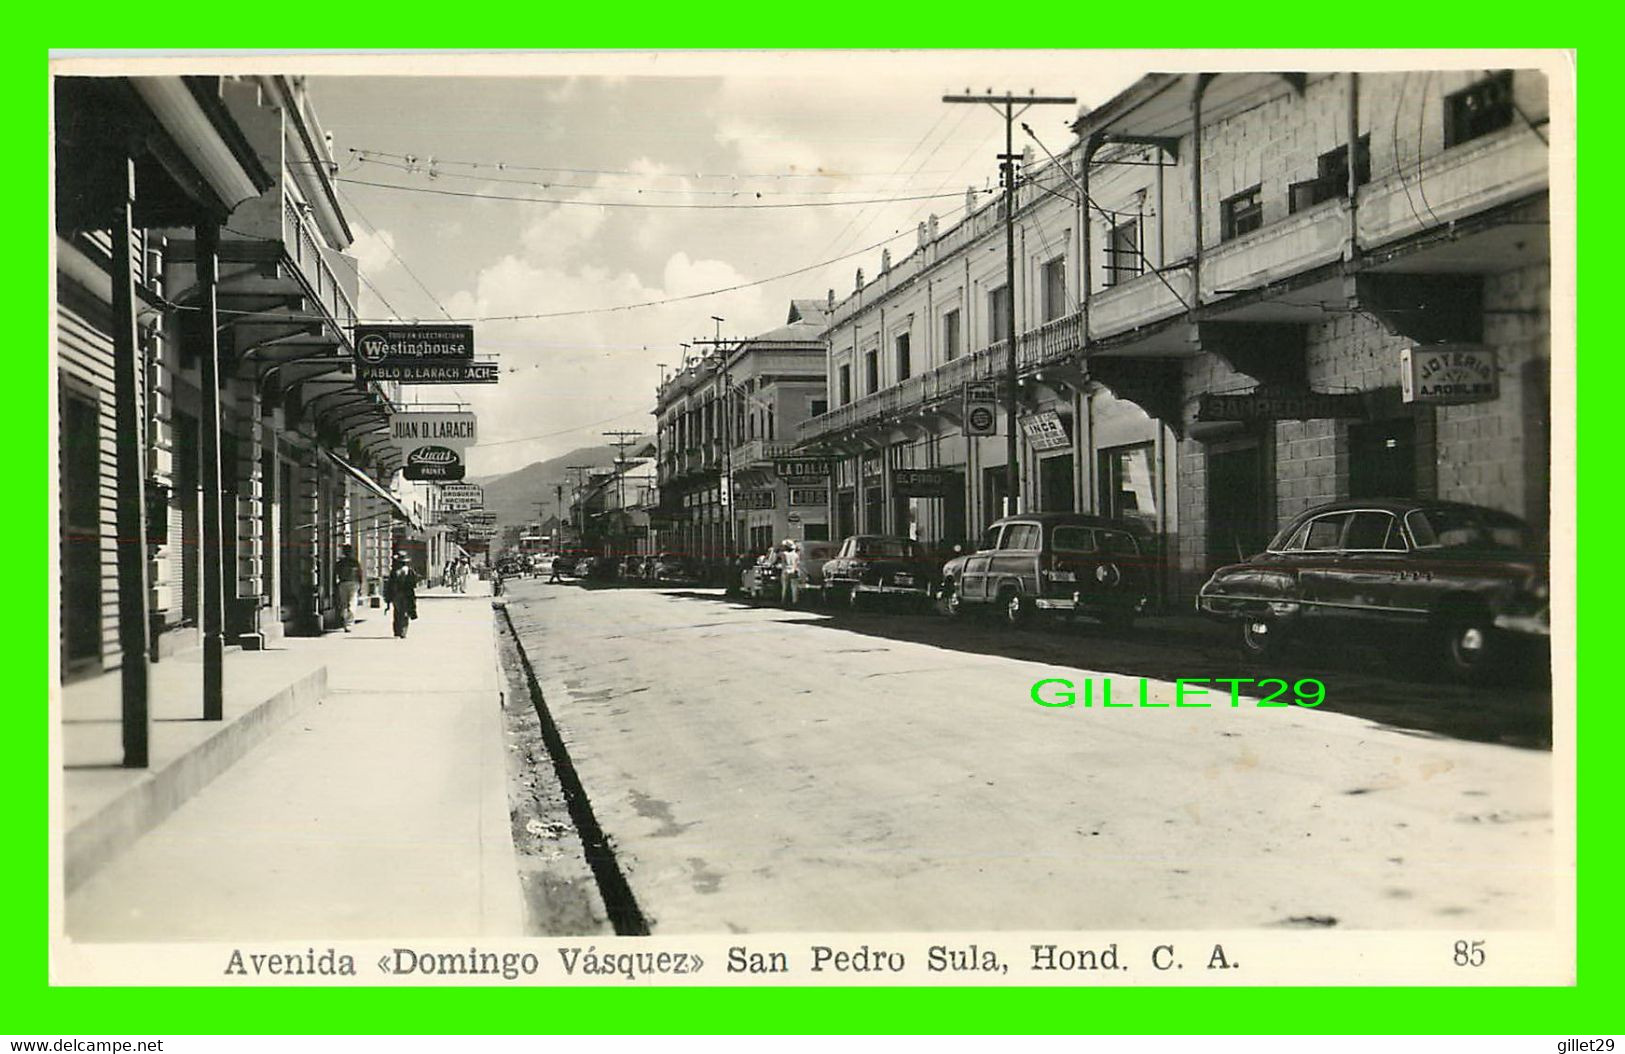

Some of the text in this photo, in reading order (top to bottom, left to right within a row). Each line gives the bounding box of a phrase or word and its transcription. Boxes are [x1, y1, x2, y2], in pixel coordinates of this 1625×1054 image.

[363, 340, 466, 358] Westinghouse
[363, 367, 401, 379] PABLO
[416, 367, 460, 379] LARACH
[392, 421, 418, 439] JUAN
[433, 421, 474, 439] LARACH
[410, 446, 458, 464] Lucas
[777, 462, 792, 476] LA
[795, 462, 830, 476] DALIA
